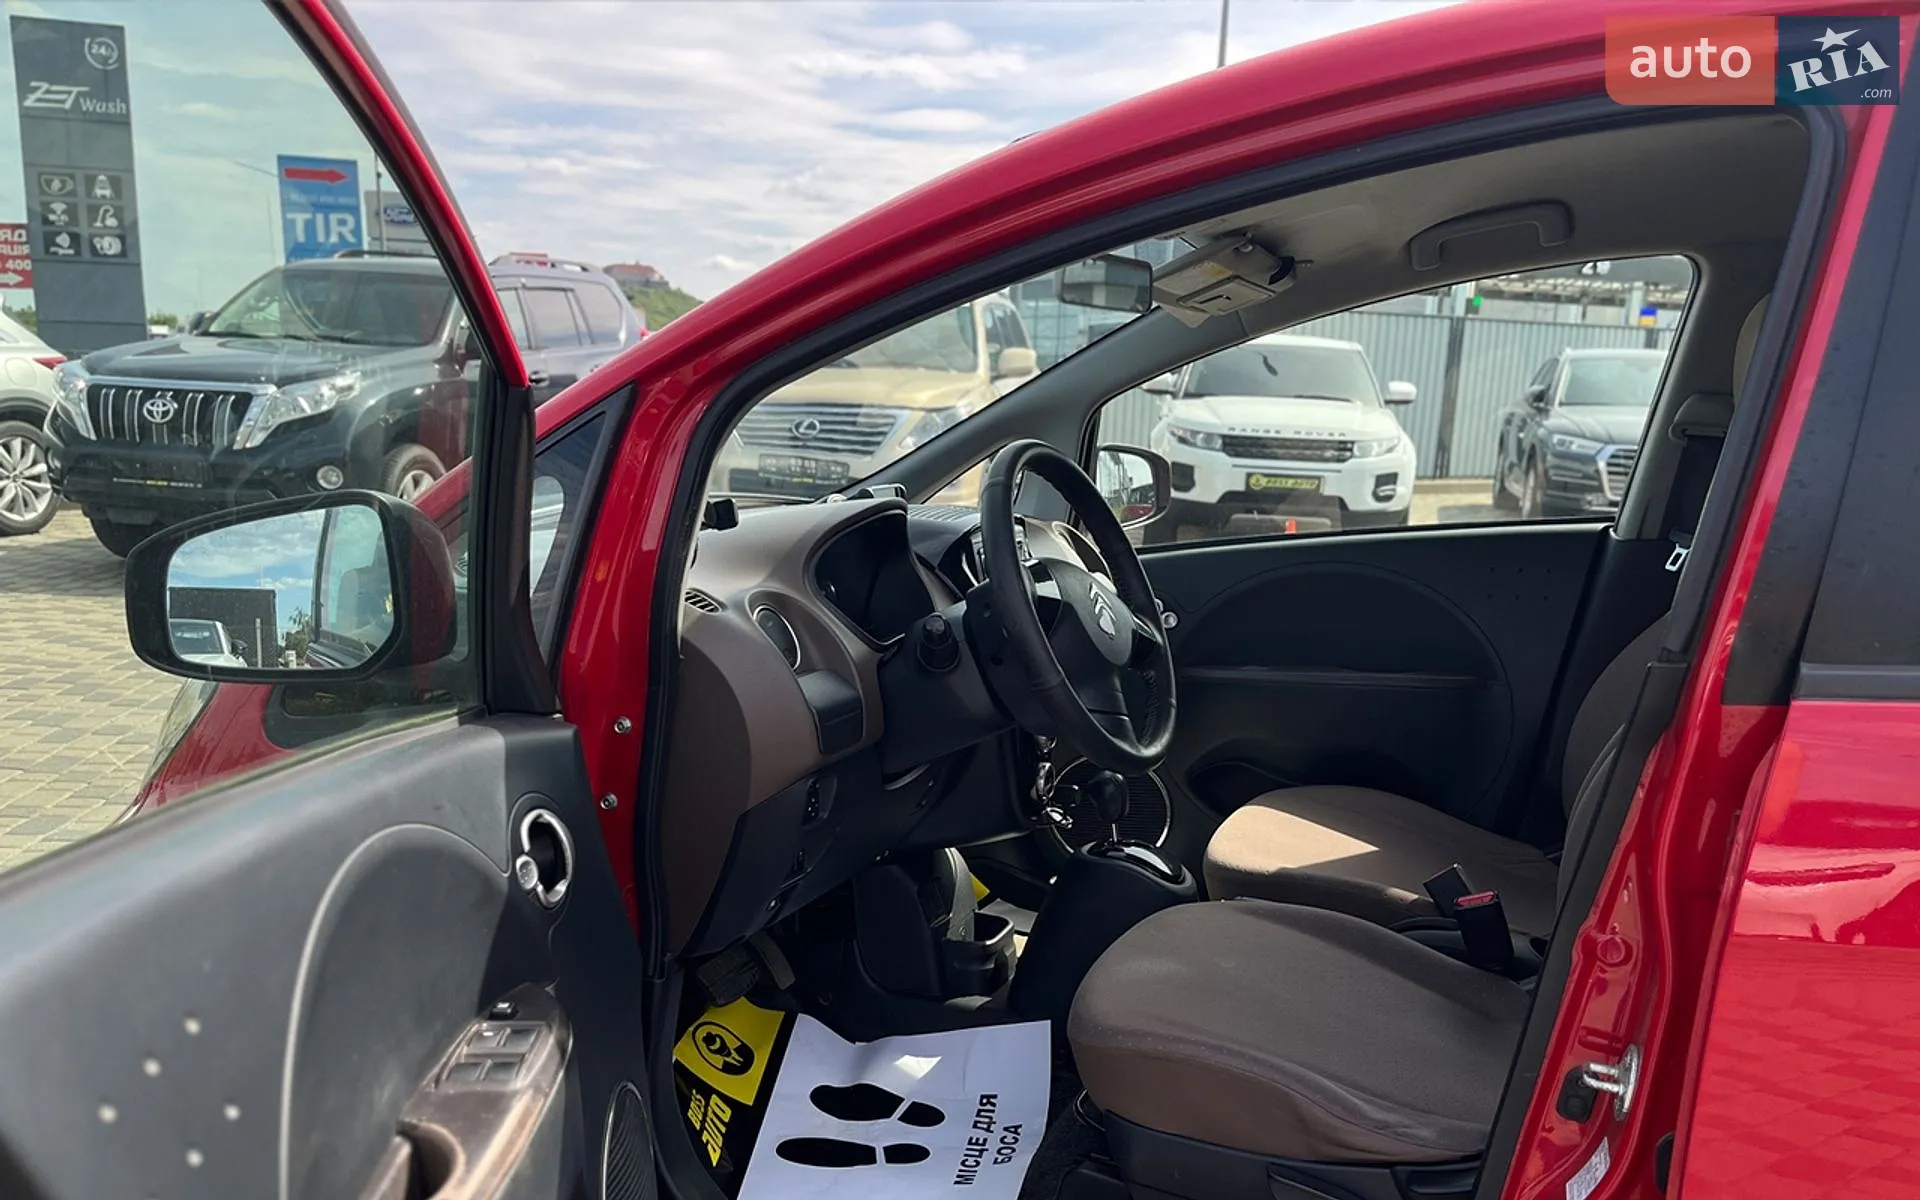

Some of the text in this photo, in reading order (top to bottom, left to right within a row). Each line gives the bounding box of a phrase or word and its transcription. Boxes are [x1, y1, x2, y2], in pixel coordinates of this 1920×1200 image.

[23, 81, 127, 114] ZET Wash
[286, 212, 357, 242] TIR
[1228, 426, 1282, 434] RANGE
[702, 1093, 732, 1168] AUTO
[953, 1093, 998, 1185] МІСЦЕ ДЛЯ
[992, 1124, 1023, 1165] БОСА
